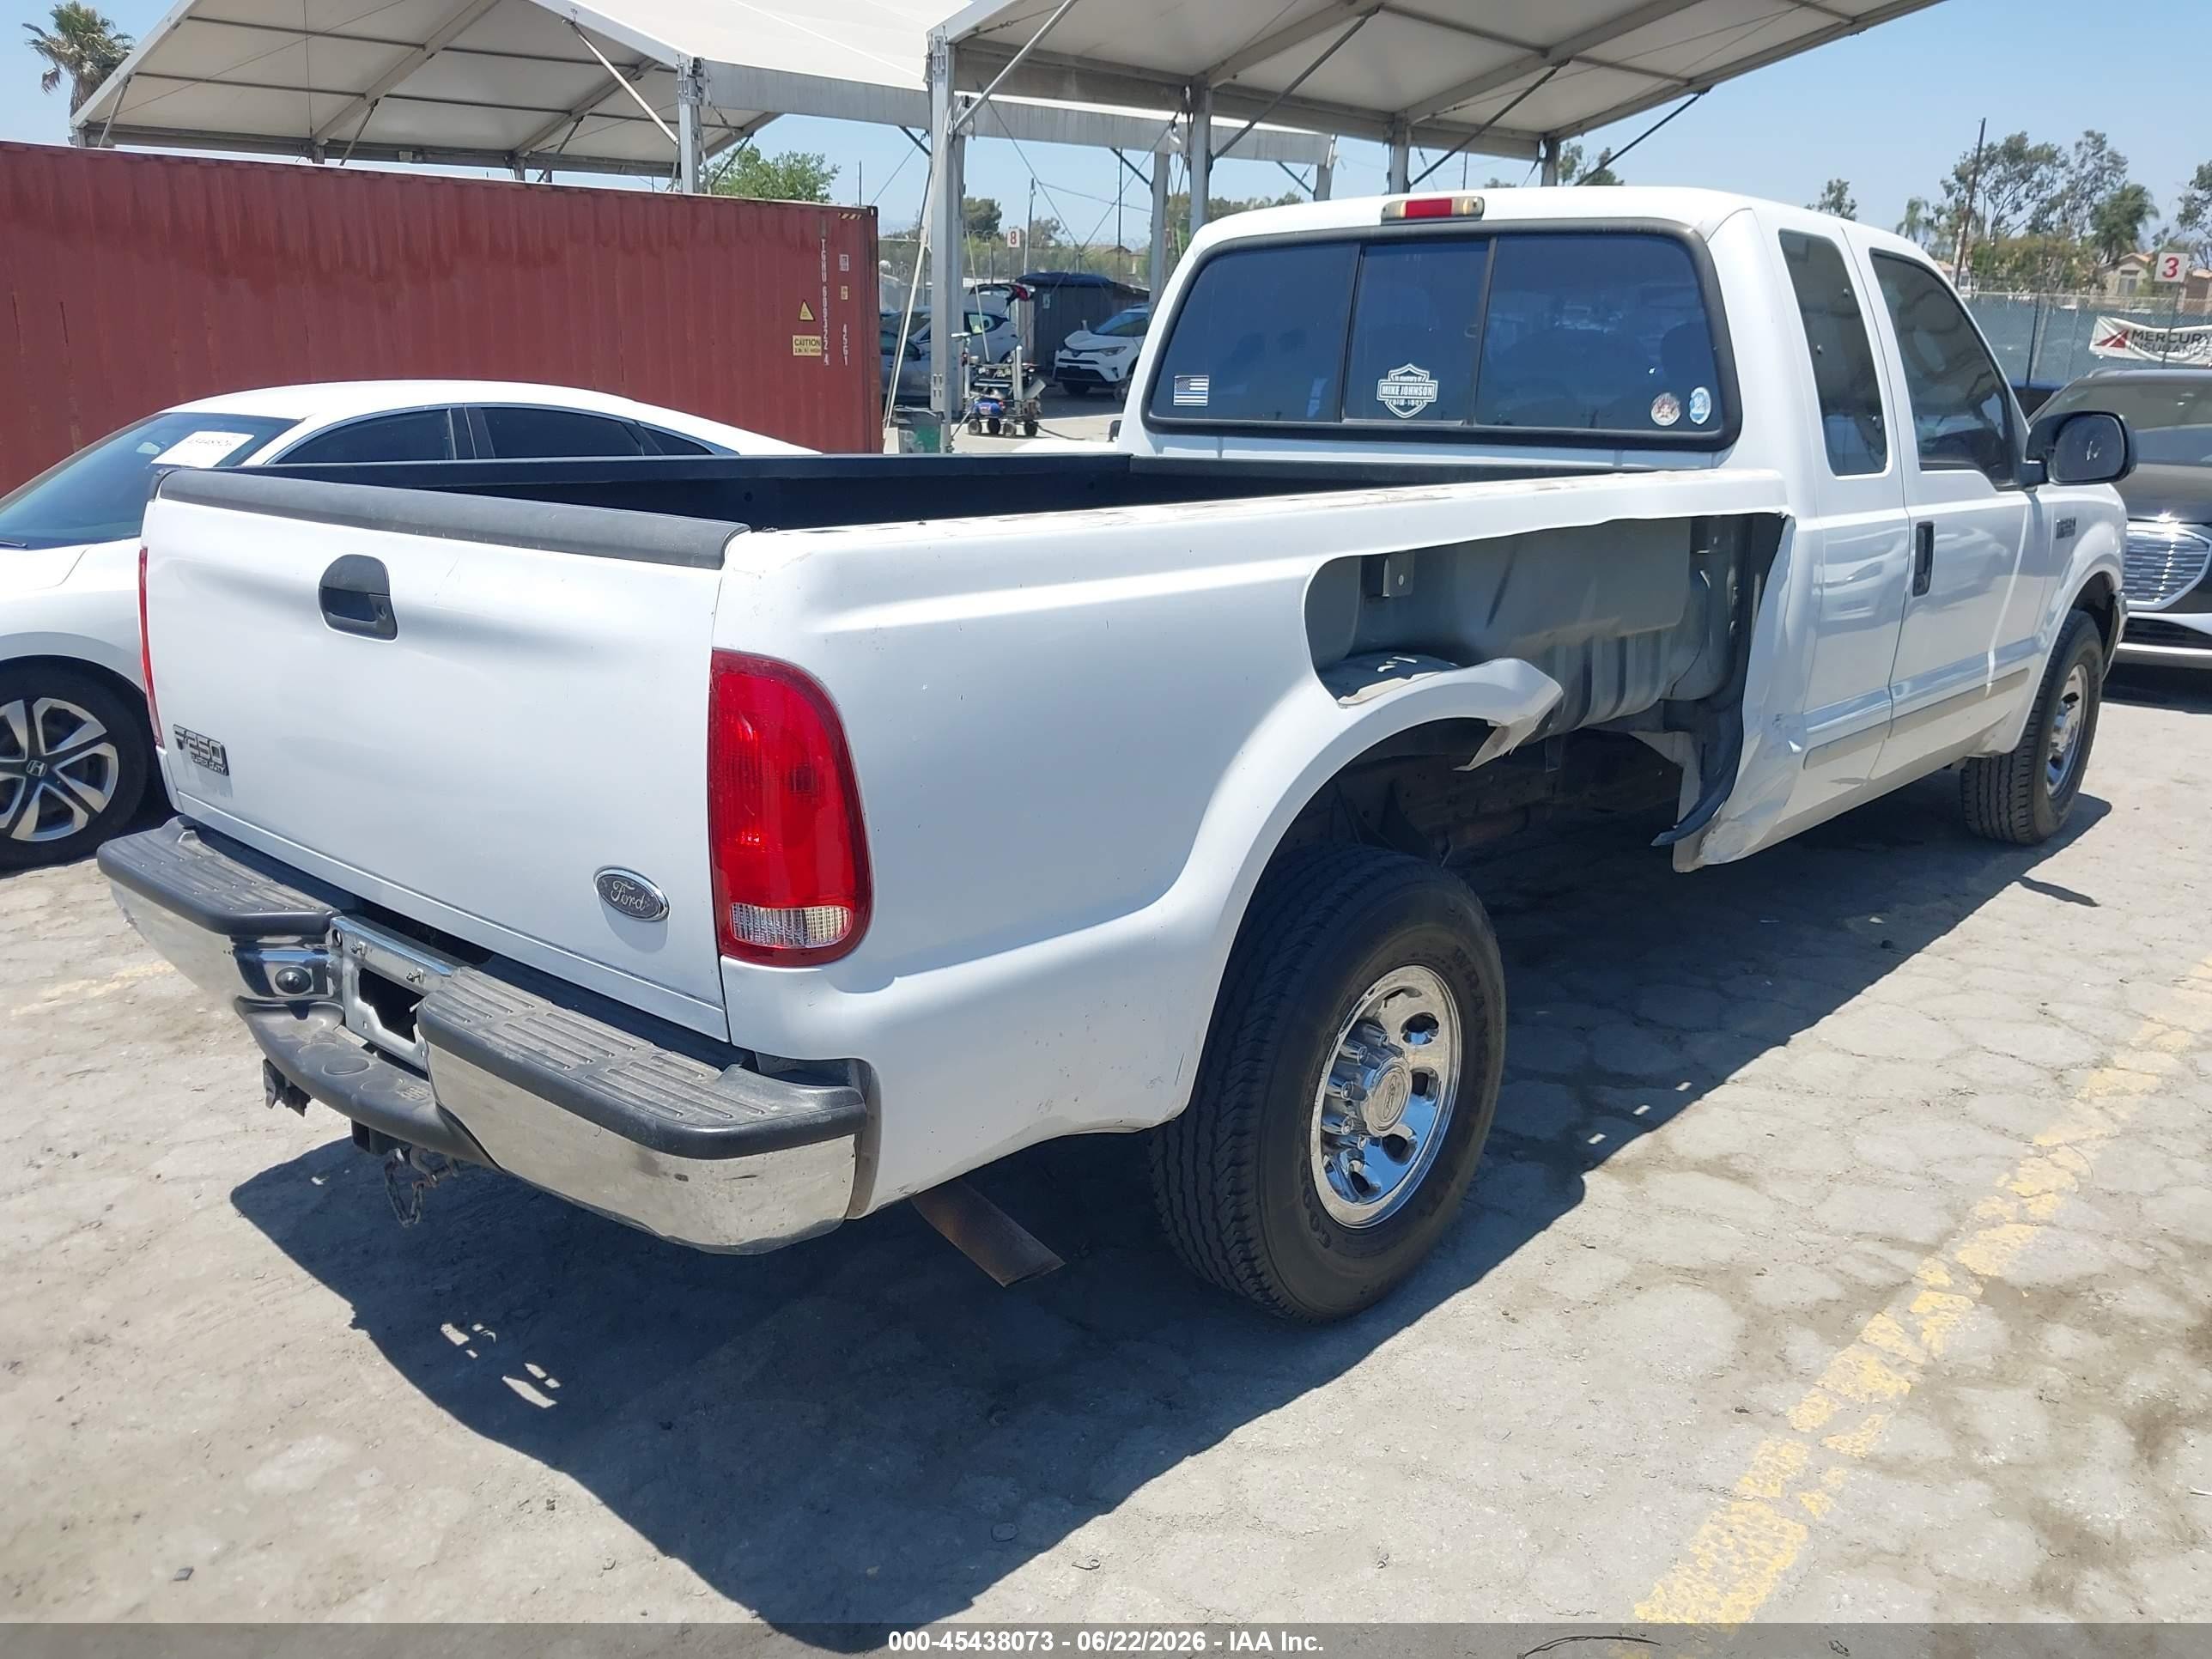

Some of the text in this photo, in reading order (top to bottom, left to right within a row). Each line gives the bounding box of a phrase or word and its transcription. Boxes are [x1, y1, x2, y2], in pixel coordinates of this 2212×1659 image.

[1010, 230, 1017, 245] 8
[2162, 256, 2179, 278] 3
[794, 338, 821, 347] CAUTION
[1382, 385, 1433, 396] MIKE JOHNSON
[611, 879, 646, 911] Ford
